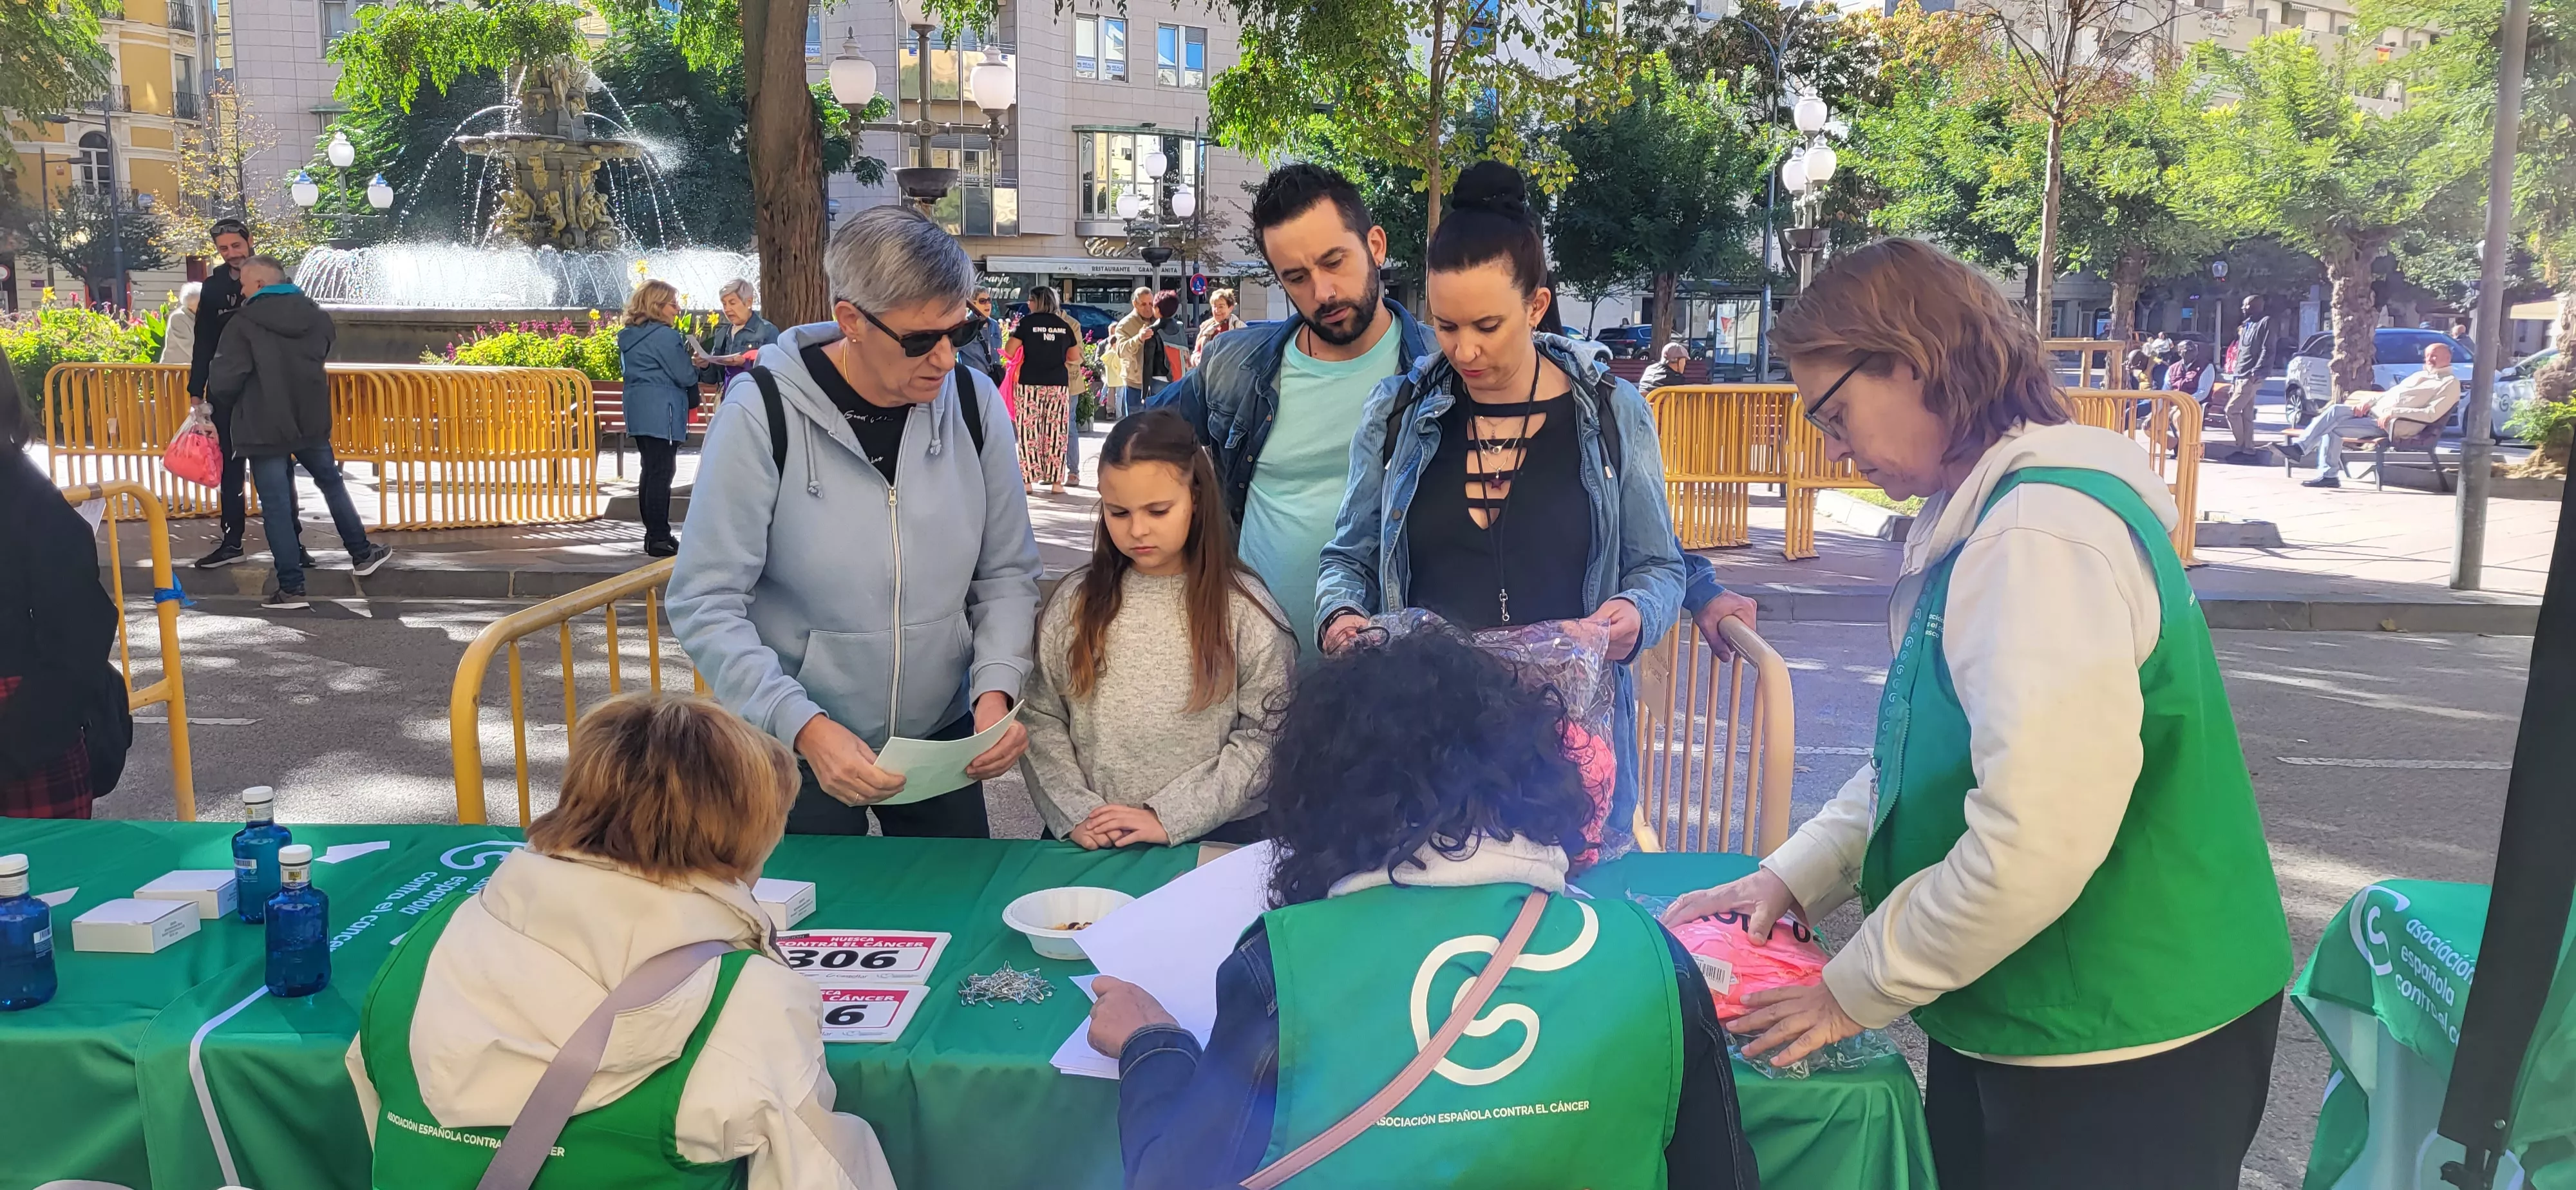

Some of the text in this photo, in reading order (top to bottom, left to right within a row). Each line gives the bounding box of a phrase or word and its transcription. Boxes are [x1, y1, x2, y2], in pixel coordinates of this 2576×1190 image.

[988, 287, 1021, 299] NITA
[385, 872, 438, 900] contra
[399, 876, 468, 916] española
[370, 902, 393, 912] el
[788, 949, 900, 969] 306
[2401, 945, 2455, 1006] española
[1438, 1108, 1492, 1123] ESPAÑOLA
[1493, 1104, 1535, 1119] CONTRA
[1535, 1103, 1549, 1114] EL
[1549, 1100, 1589, 1113] CÁNCER
[387, 1110, 502, 1149] ASOCIACIÓN ESPAÑOLA CONTRA
